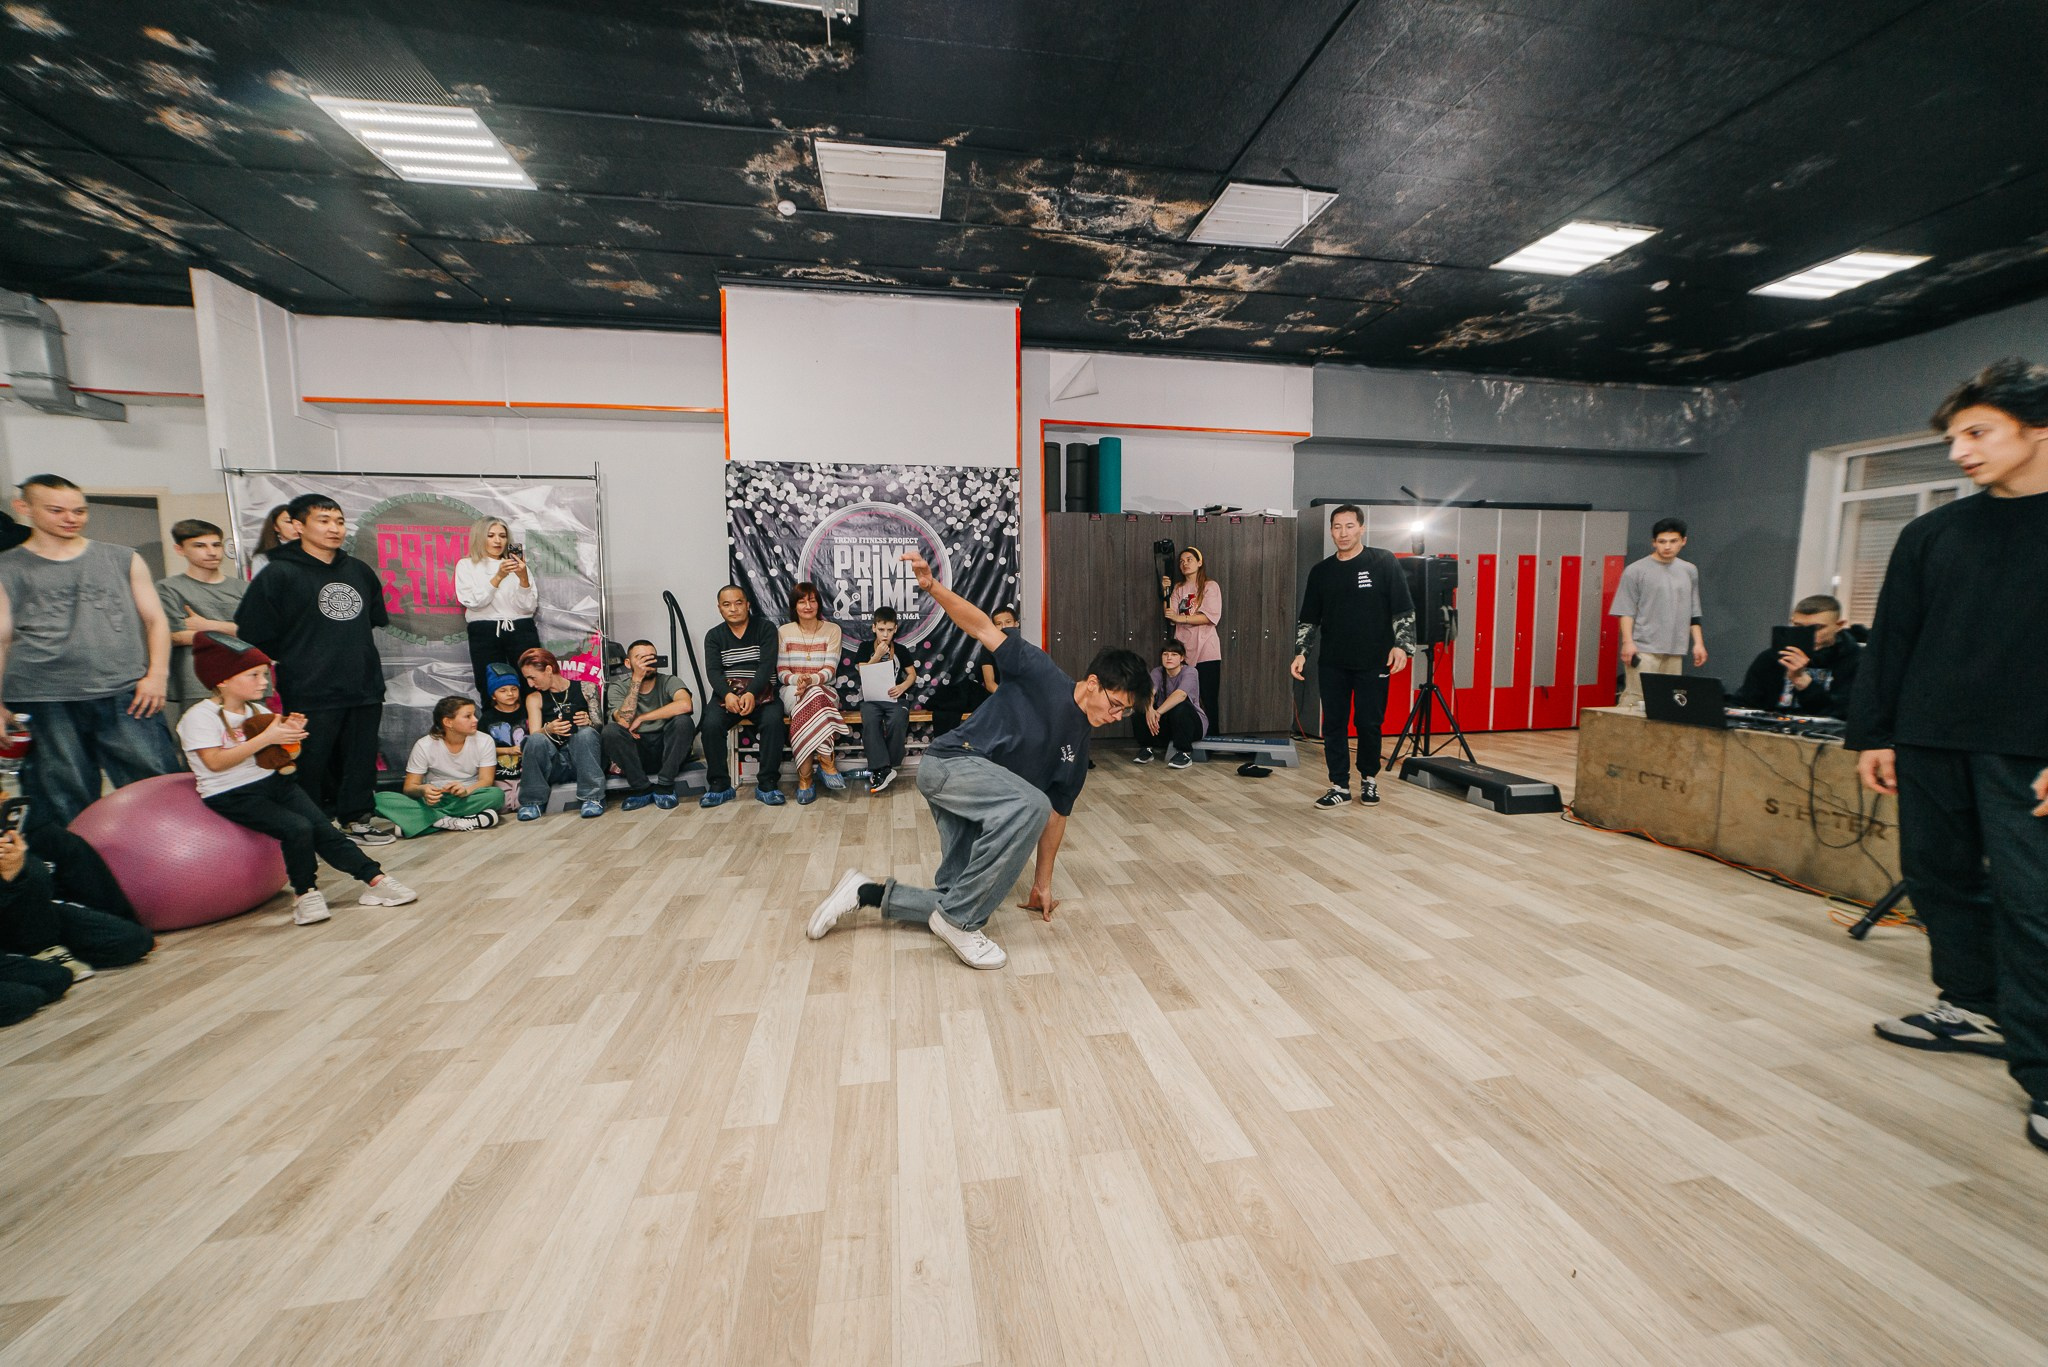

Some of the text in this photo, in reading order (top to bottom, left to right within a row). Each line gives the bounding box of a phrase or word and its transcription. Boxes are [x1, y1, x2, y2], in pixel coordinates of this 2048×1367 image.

[888, 537, 918, 545] PROJECT
[406, 570, 462, 606] TIM
[856, 579, 920, 612] TIME
[556, 660, 586, 673] IME
